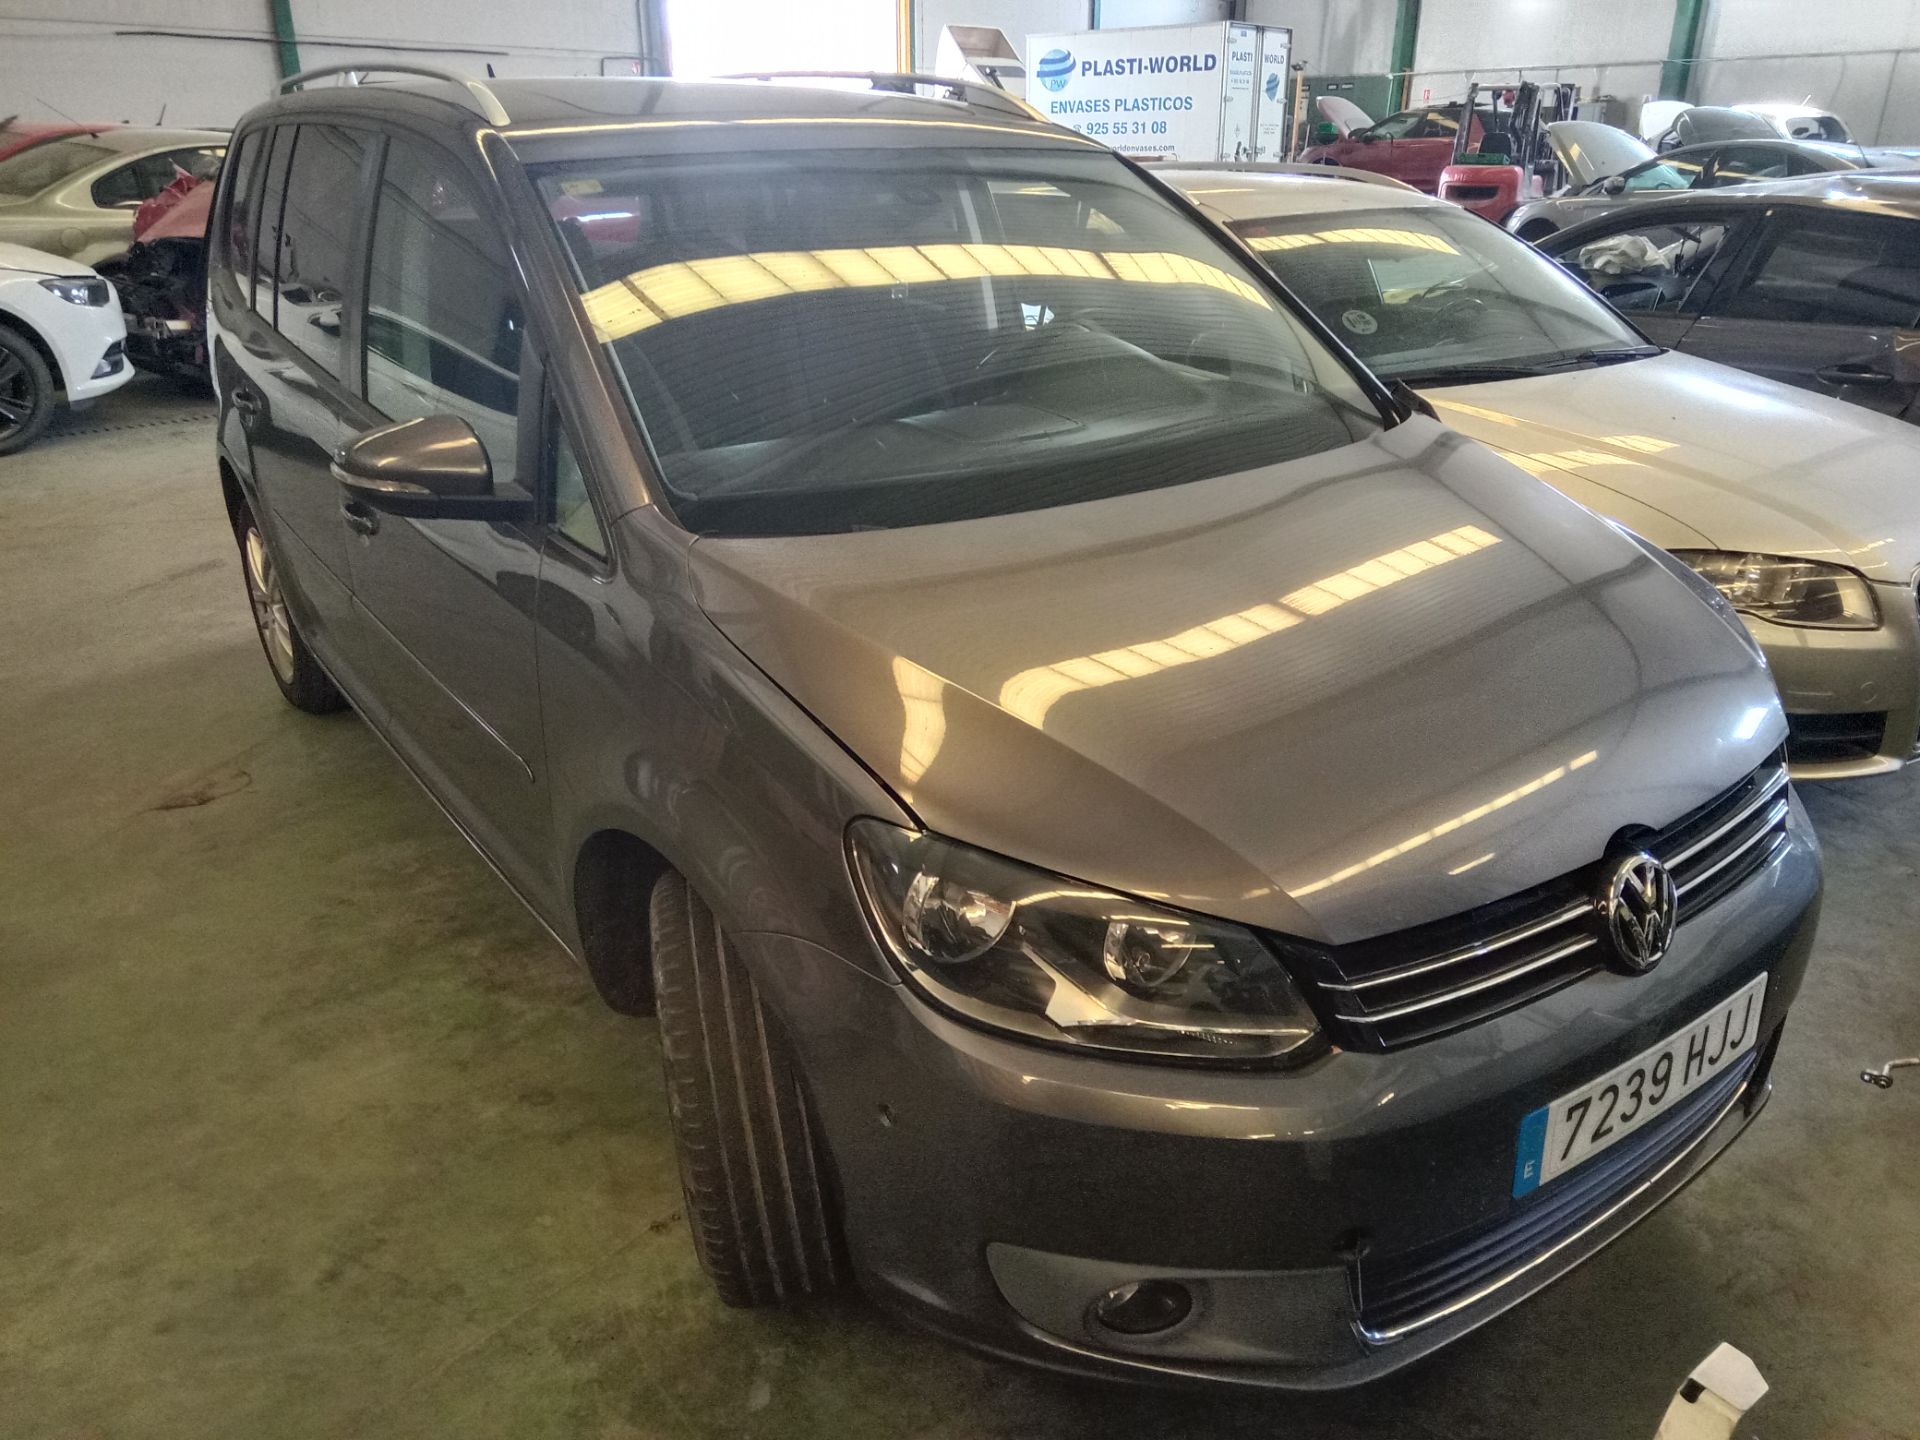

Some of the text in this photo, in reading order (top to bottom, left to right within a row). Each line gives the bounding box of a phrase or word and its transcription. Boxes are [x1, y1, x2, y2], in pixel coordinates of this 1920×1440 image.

[1081, 53, 1217, 77] PLASTI-WORLD
[1231, 50, 1286, 65] PLASTI WORLD
[1050, 95, 1194, 115] ENVASES PLASTICOS
[1086, 120, 1168, 135] 925 55 31 08
[1560, 993, 1754, 1161] 7239 HJJ
[1523, 1159, 1536, 1179] E
